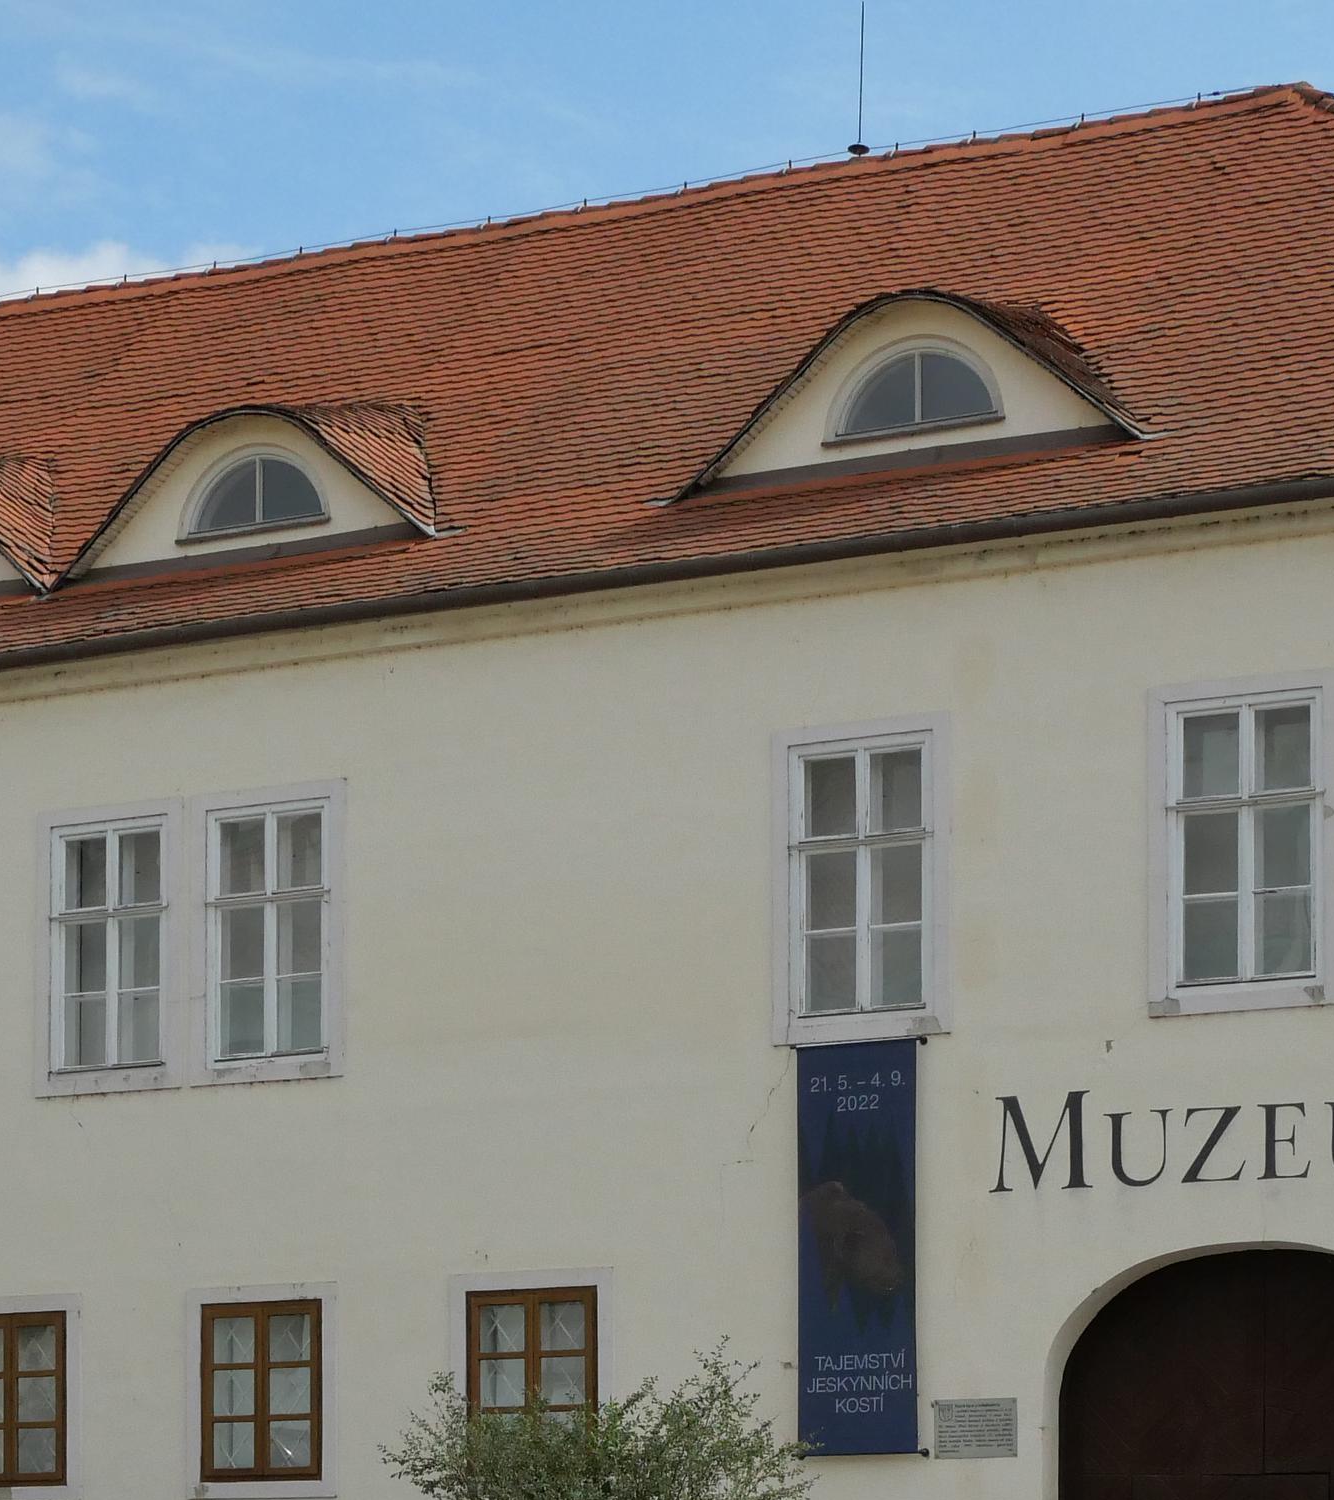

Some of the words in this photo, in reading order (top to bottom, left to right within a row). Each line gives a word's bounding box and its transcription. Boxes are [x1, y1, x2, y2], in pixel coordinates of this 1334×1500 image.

[810, 1076, 832, 1093] 21.
[837, 1074, 852, 1090] 5.
[870, 1071, 886, 1088] 4.
[890, 1070, 906, 1086] 9.
[837, 1094, 879, 1112] 2022
[814, 1348, 906, 1372] TAJEMSTVÍ
[807, 1370, 913, 1394] JESKYNNÍCH
[835, 1392, 885, 1414] KOSTÍ
